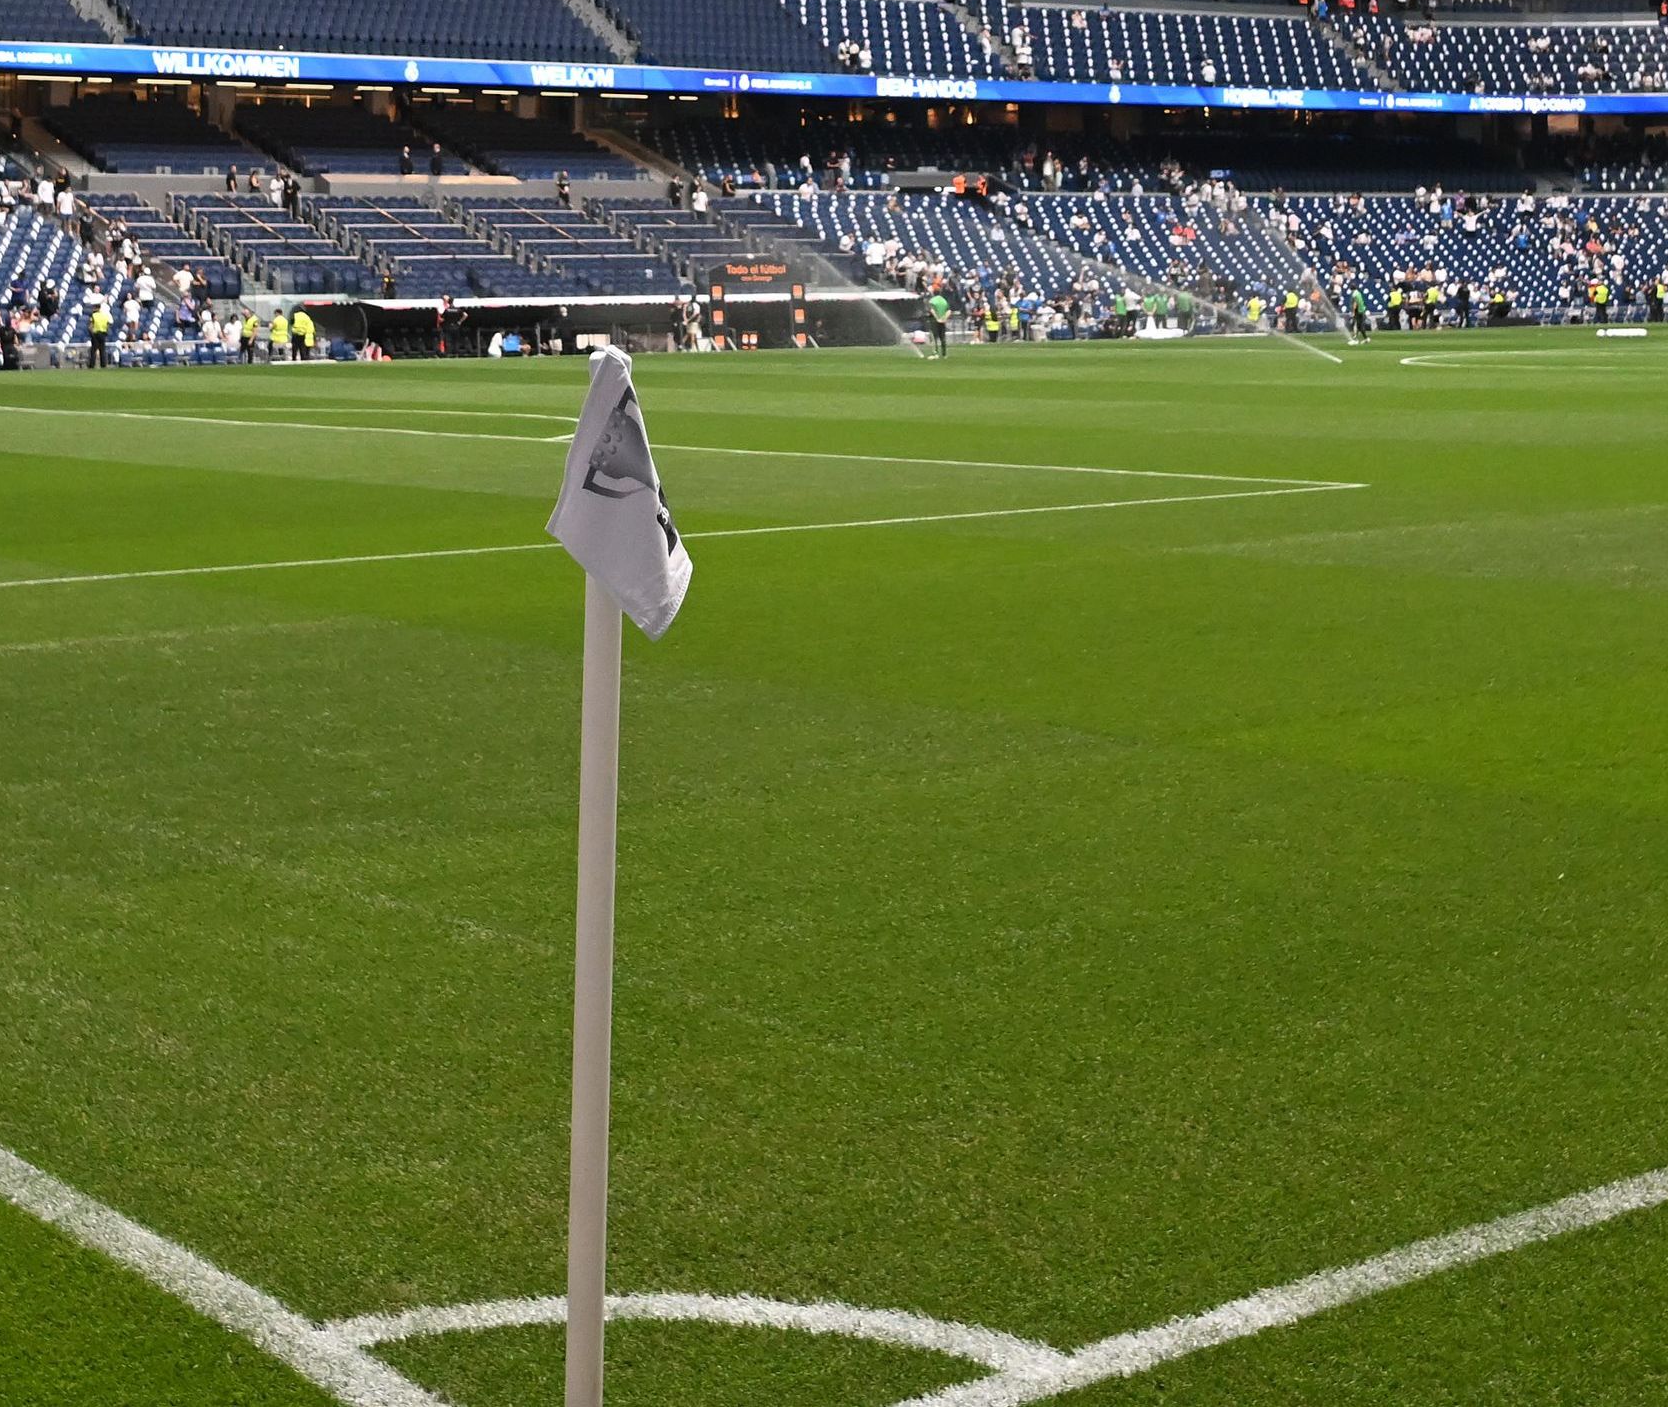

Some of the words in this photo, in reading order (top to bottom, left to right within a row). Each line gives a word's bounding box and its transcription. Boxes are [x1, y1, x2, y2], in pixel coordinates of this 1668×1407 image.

[153, 51, 299, 78] WILLKOMMEN
[531, 65, 614, 88] WELKOM
[877, 78, 977, 99] BEM-VINDOS
